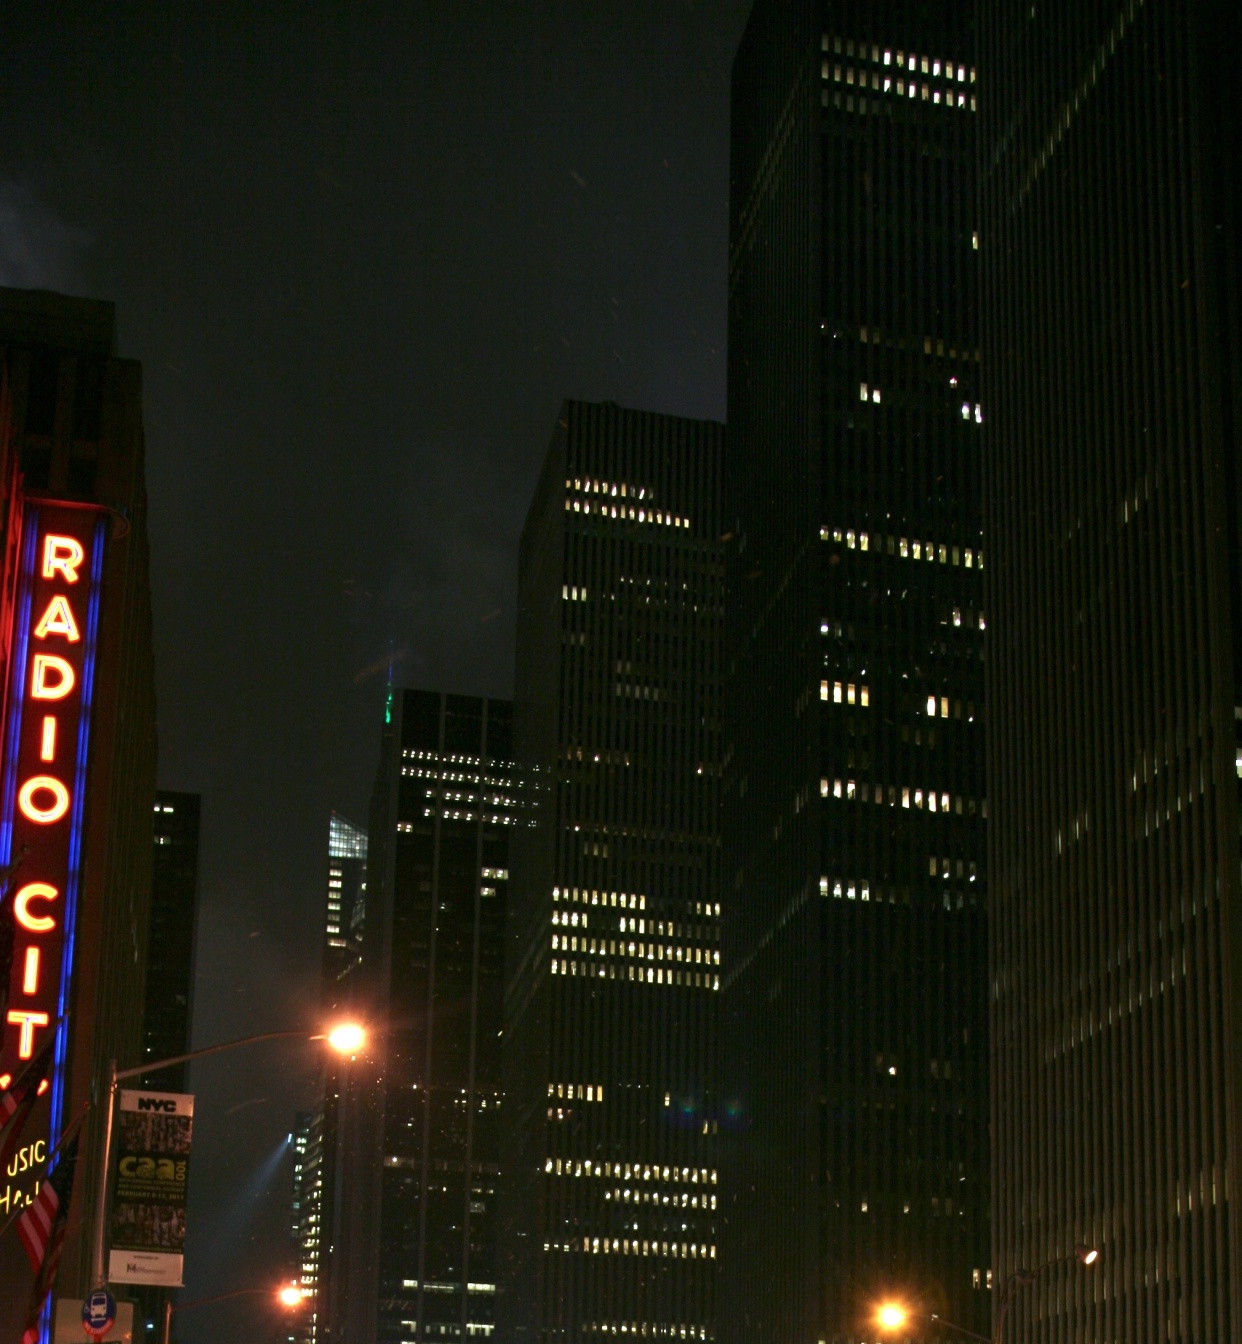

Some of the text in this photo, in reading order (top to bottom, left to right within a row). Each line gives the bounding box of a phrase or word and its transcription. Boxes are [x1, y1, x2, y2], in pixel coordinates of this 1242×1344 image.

[18, 533, 84, 825] RADIO
[1, 882, 58, 1094] CIT
[137, 1097, 177, 1112] NYC
[7, 1140, 45, 1177] USIC
[119, 1156, 175, 1180] caa
[116, 1189, 151, 1199] FEBRUARY
